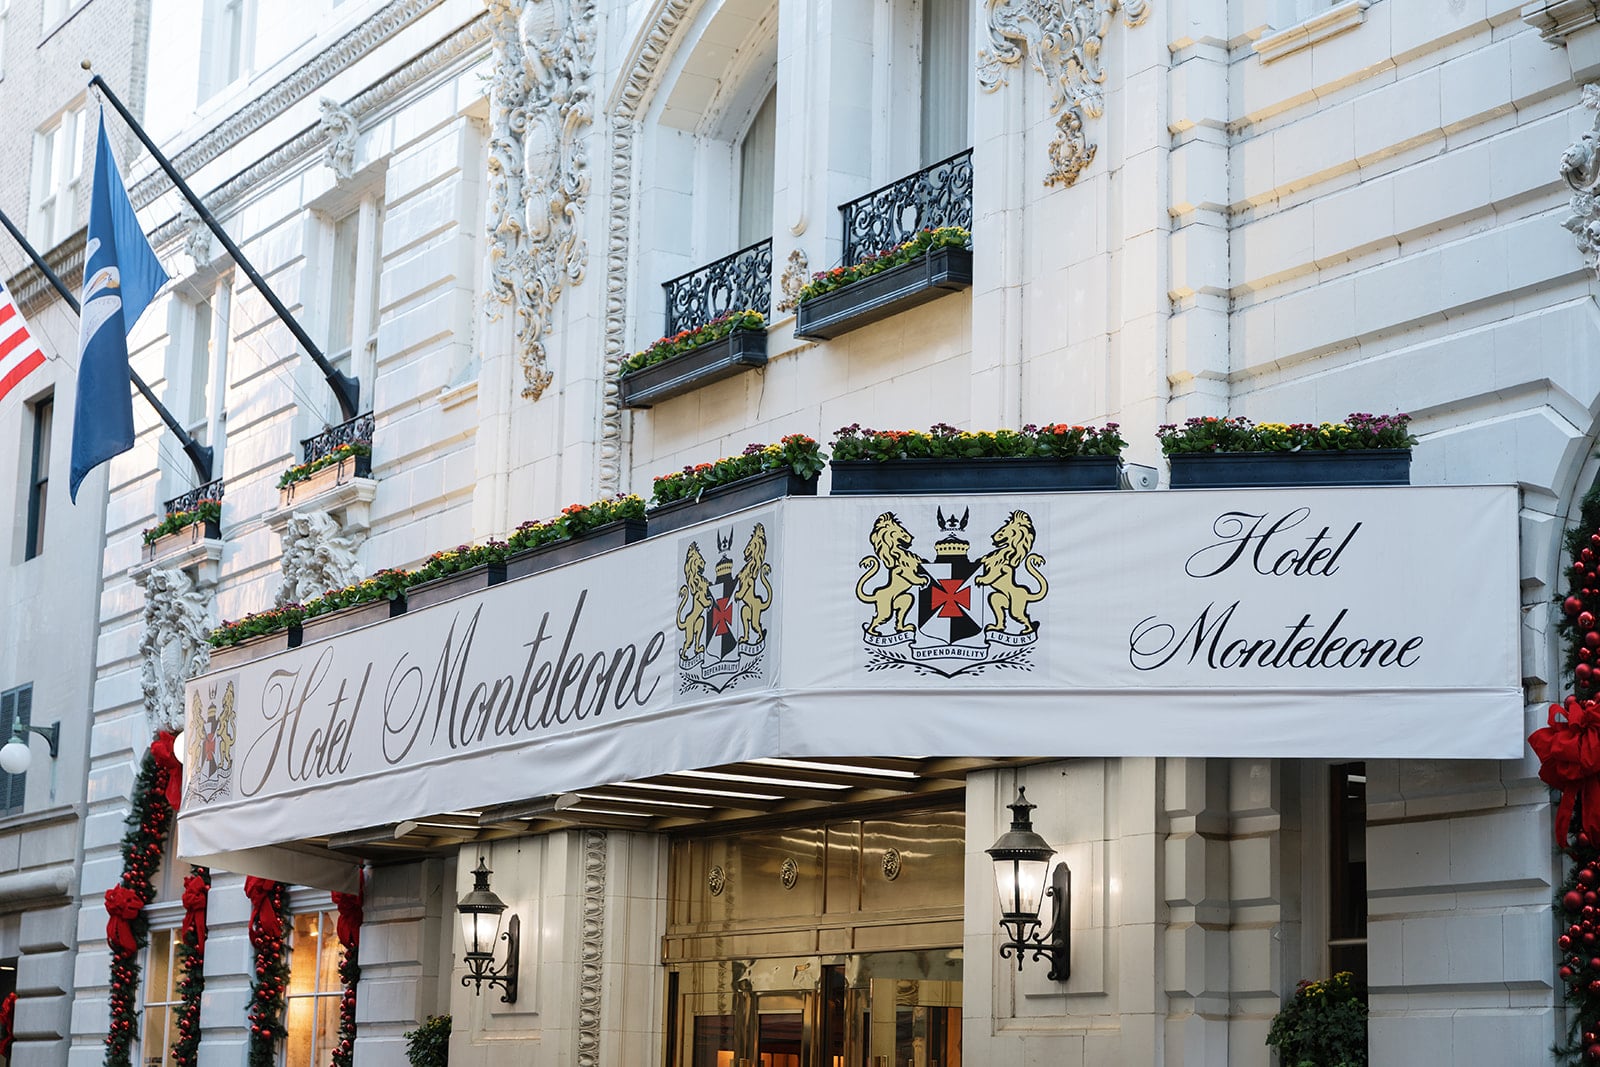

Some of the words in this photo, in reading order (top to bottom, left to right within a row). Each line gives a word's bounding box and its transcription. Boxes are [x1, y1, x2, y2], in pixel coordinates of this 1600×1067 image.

[1185, 507, 1362, 578] Hotel
[868, 632, 910, 645] SERVICE
[916, 648, 986, 658] DEPENDABILITY
[990, 632, 1033, 645] LUXURY
[1129, 600, 1424, 671] Monteleone
[239, 645, 373, 797] Hotel
[382, 589, 666, 765] Monteleone
